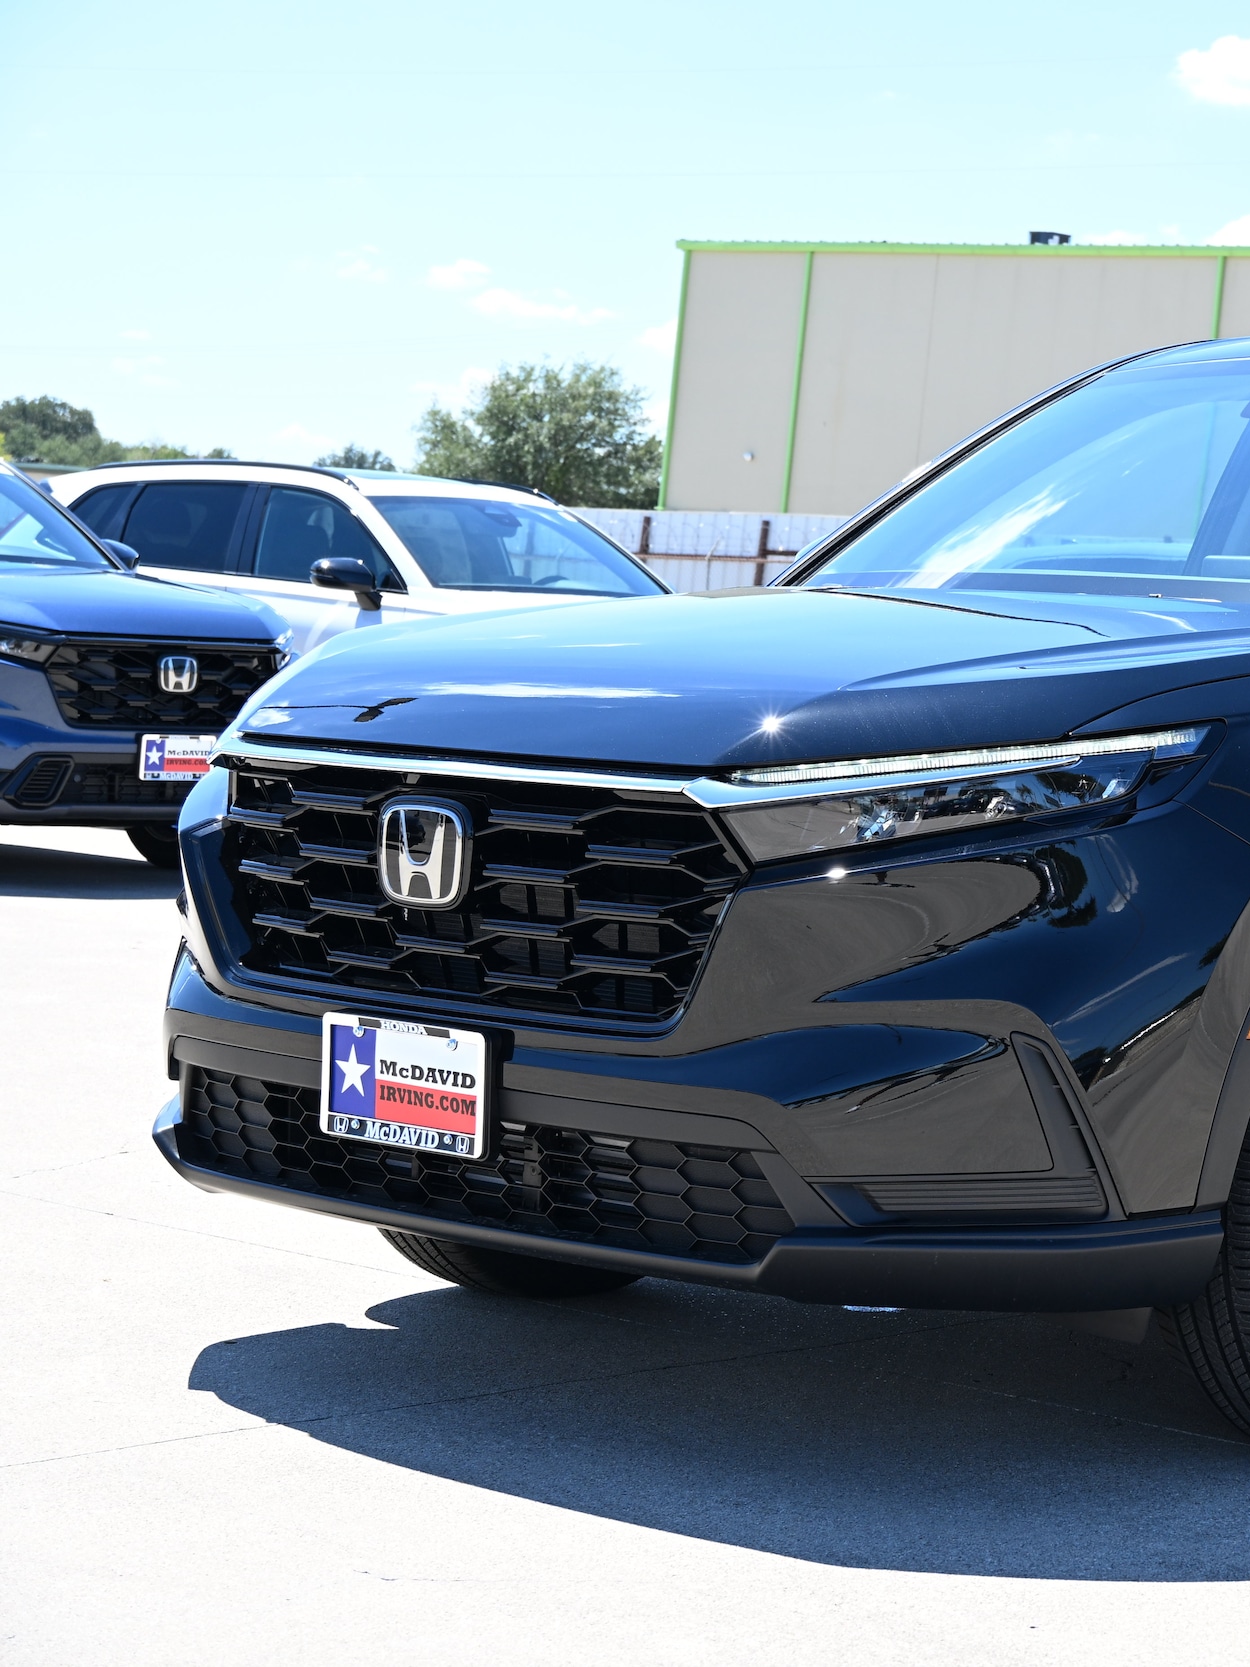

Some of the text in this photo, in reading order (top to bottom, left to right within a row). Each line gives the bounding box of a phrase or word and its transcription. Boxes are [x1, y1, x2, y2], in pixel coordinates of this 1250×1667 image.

[379, 1019, 428, 1036] HONDA
[379, 1059, 476, 1089] McDAVID
[379, 1084, 477, 1117] IRVING.COM
[364, 1120, 440, 1149] McDAVID
